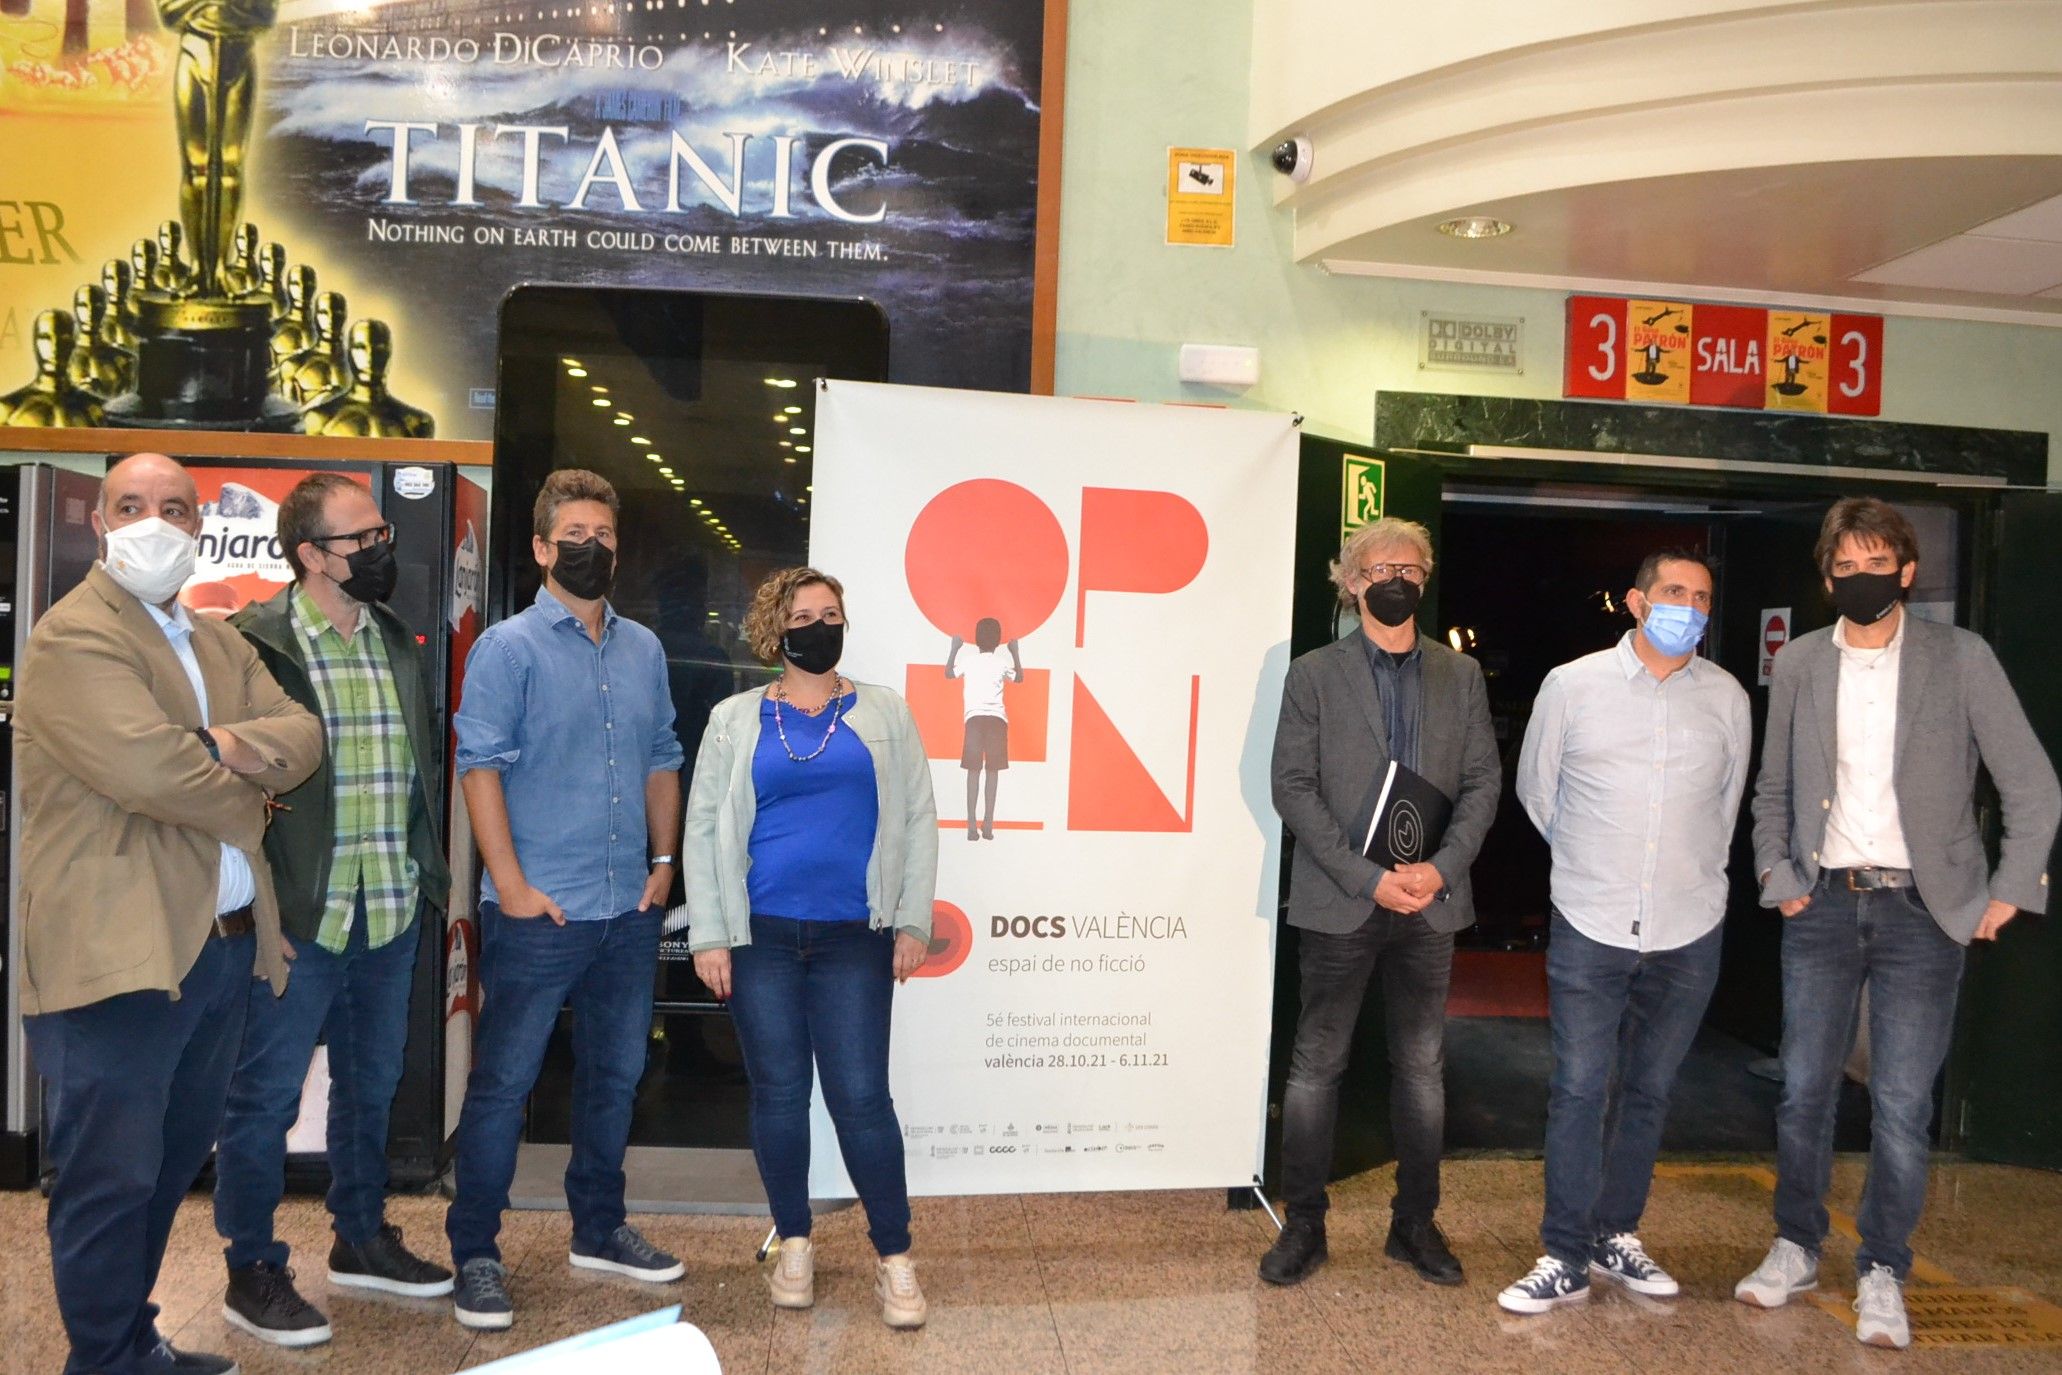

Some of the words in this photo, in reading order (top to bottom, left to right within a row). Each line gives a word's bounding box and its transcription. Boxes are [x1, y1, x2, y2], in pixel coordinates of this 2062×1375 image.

[289, 26, 479, 63] LEONARDO
[726, 41, 817, 79] KATE
[830, 46, 980, 87] WINSLET
[363, 119, 889, 224] TITANIC
[368, 218, 465, 244] NOTHING
[474, 226, 504, 245] ON
[514, 228, 576, 248] EARTH
[587, 231, 655, 250] COULD
[664, 235, 721, 254] COME
[731, 236, 817, 258] BETWEEN
[827, 240, 889, 262] THEM.
[1461, 324, 1514, 340] DOLBY
[1428, 339, 1517, 354] DIGITAL
[1587, 313, 1617, 382] 3
[1696, 336, 1761, 376] SALA
[1839, 330, 1867, 398] 3
[990, 914, 1067, 939] DOCS
[1071, 911, 1188, 940] VALÈNCIA
[987, 954, 1037, 977] espai
[1042, 953, 1065, 973] de
[1070, 957, 1094, 973] no
[1098, 952, 1146, 973] ficció
[986, 1012, 1004, 1027] 5é
[1007, 1011, 1056, 1027] festival
[1060, 1011, 1152, 1027] internacional
[985, 1033, 1004, 1048] de
[1007, 1033, 1059, 1048] cinema
[1062, 1032, 1147, 1047] documental
[984, 1052, 1044, 1069] valència
[1047, 1053, 1107, 1068] 28.10.21
[1119, 1052, 1169, 1067] 6.11.21
